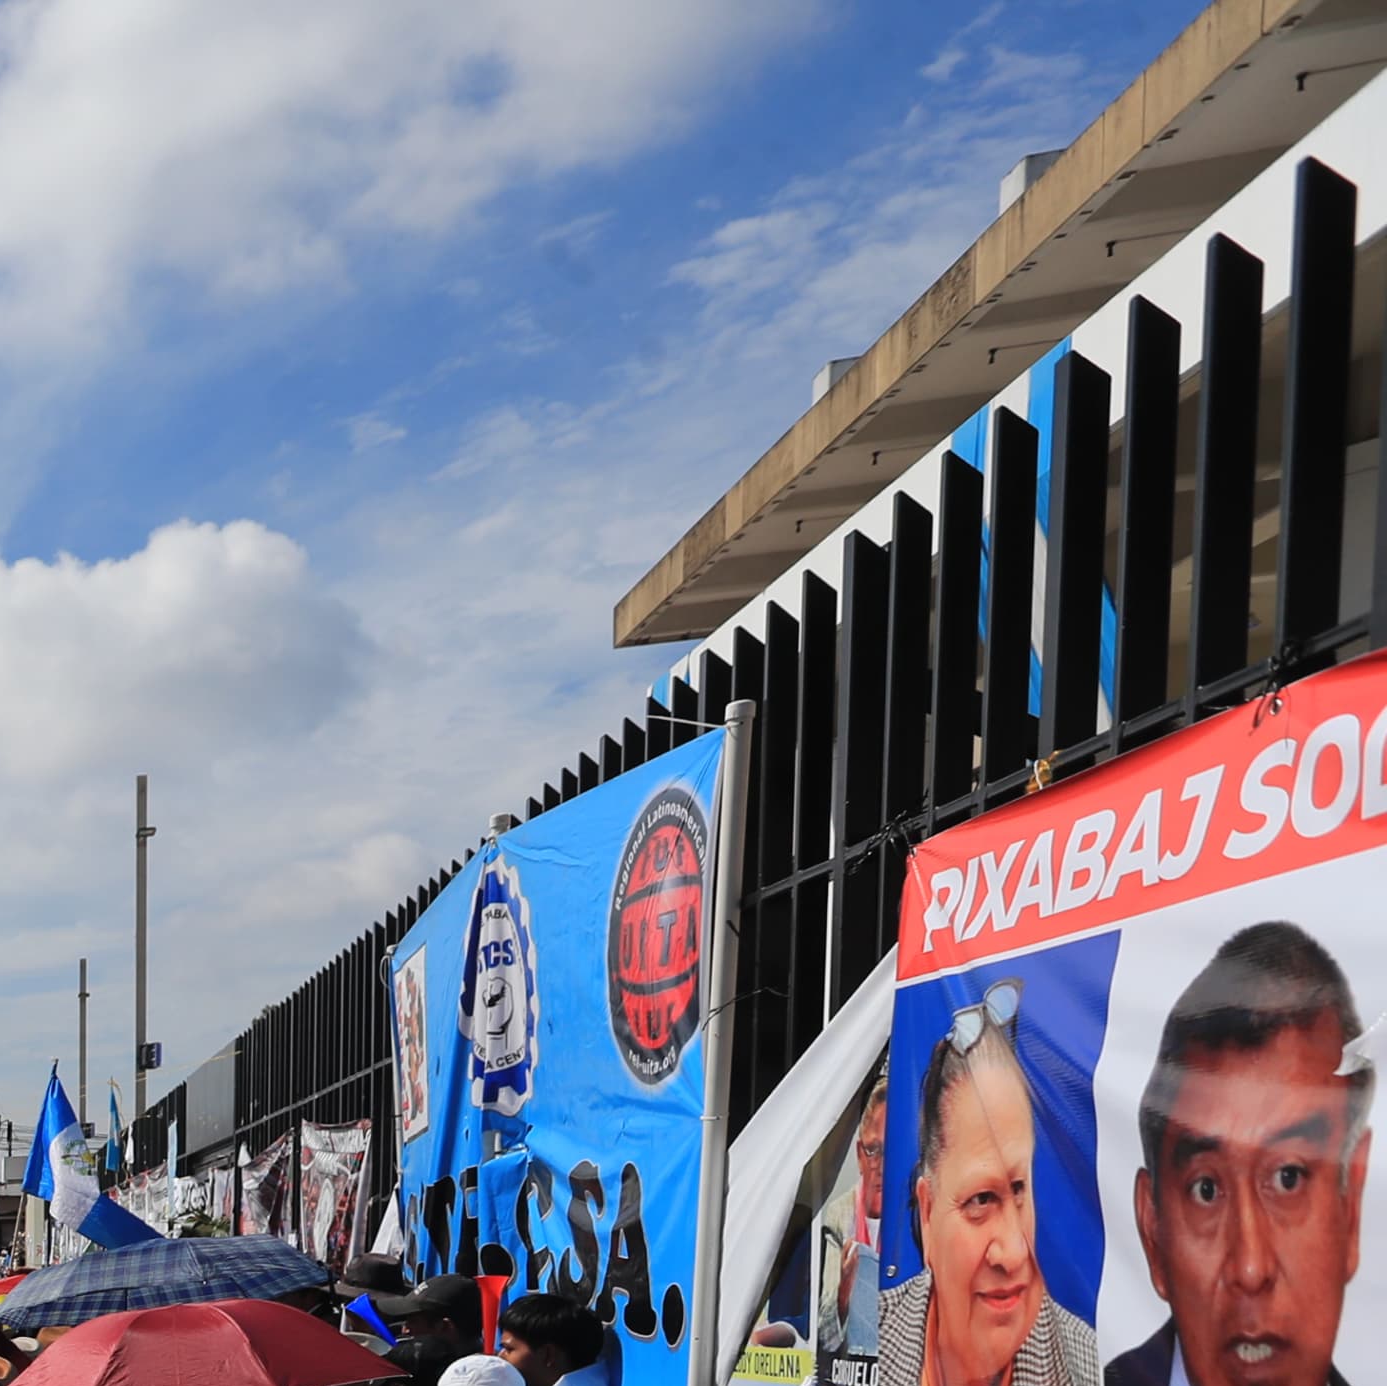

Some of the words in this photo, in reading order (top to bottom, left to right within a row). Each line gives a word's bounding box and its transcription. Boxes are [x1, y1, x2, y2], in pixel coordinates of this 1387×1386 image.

[615, 824, 647, 912] Regional
[923, 764, 1225, 953] PIXABAJ
[621, 904, 698, 972] UITA
[628, 1046, 677, 1076] rel-uita.org
[753, 1353, 802, 1379] ORELLANA
